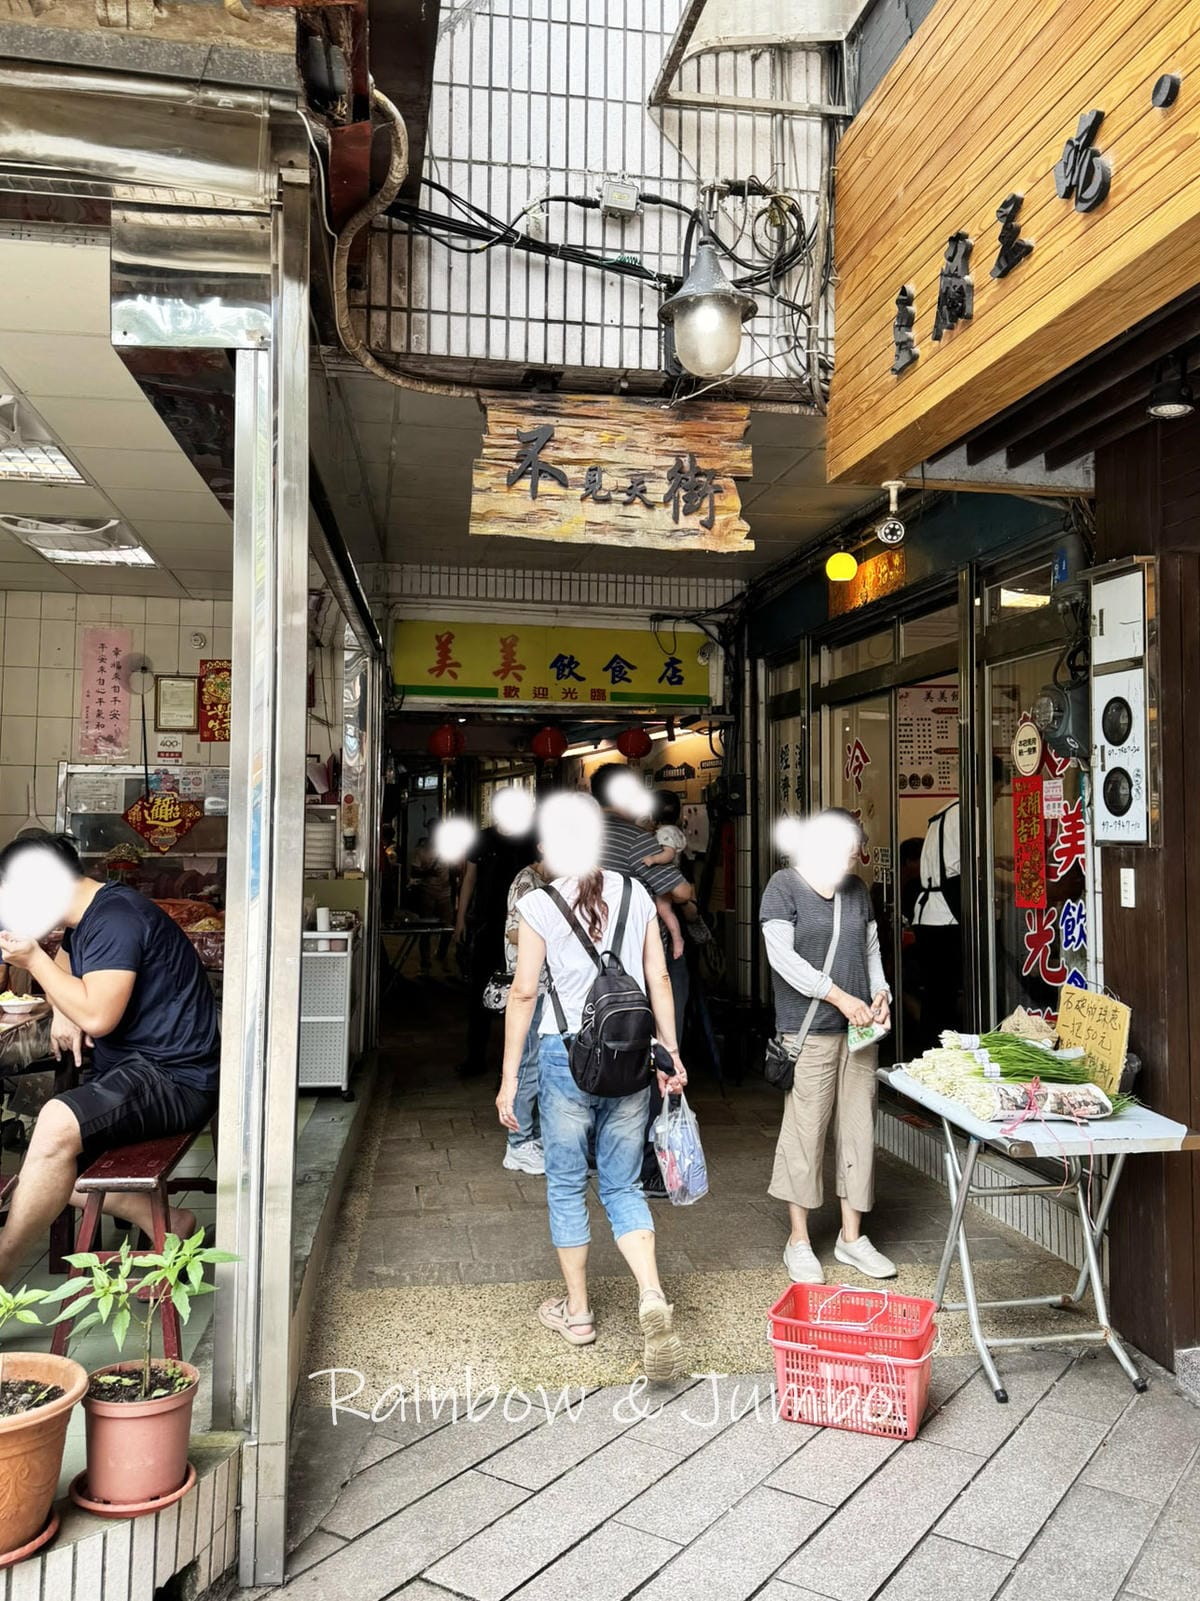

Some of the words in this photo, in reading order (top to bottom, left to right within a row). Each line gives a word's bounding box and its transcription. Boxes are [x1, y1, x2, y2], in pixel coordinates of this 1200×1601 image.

[506, 425, 723, 530] 不見天街
[428, 631, 685, 687] 美美飲食店
[503, 686, 607, 702] 歡迎光臨
